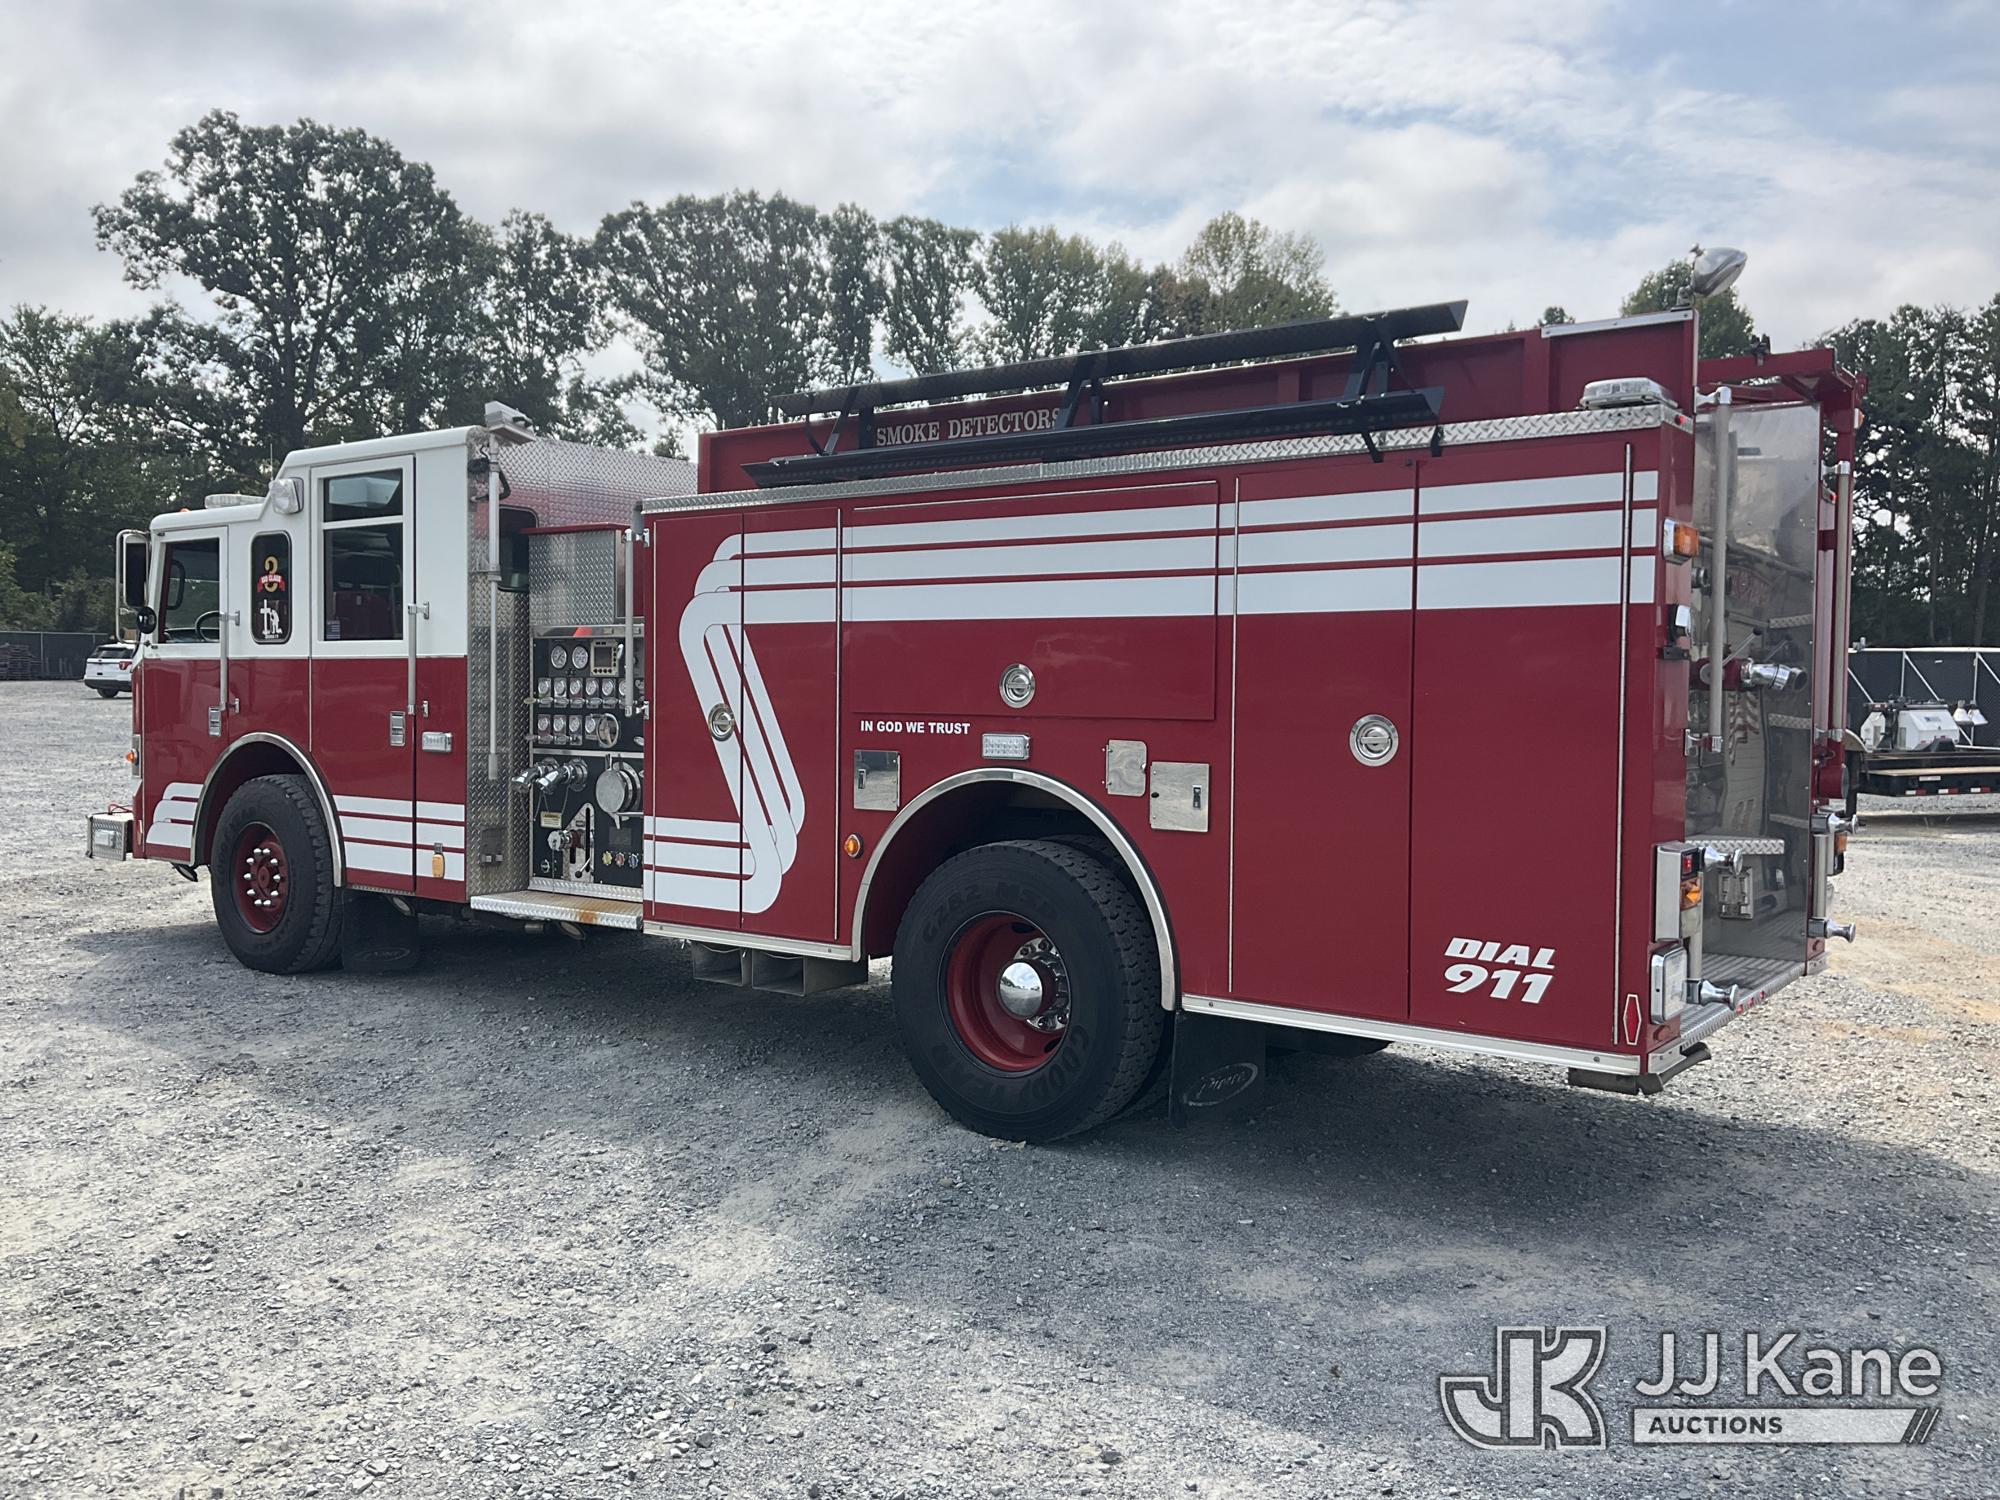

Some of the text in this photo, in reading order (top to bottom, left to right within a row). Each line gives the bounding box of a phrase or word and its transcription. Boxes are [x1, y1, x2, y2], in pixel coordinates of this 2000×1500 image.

[876, 421, 940, 447] SMOKE
[860, 720, 970, 735] IN GOD WE TRUST
[1444, 937, 1556, 970] DIAL
[1444, 963, 1553, 1004] 911
